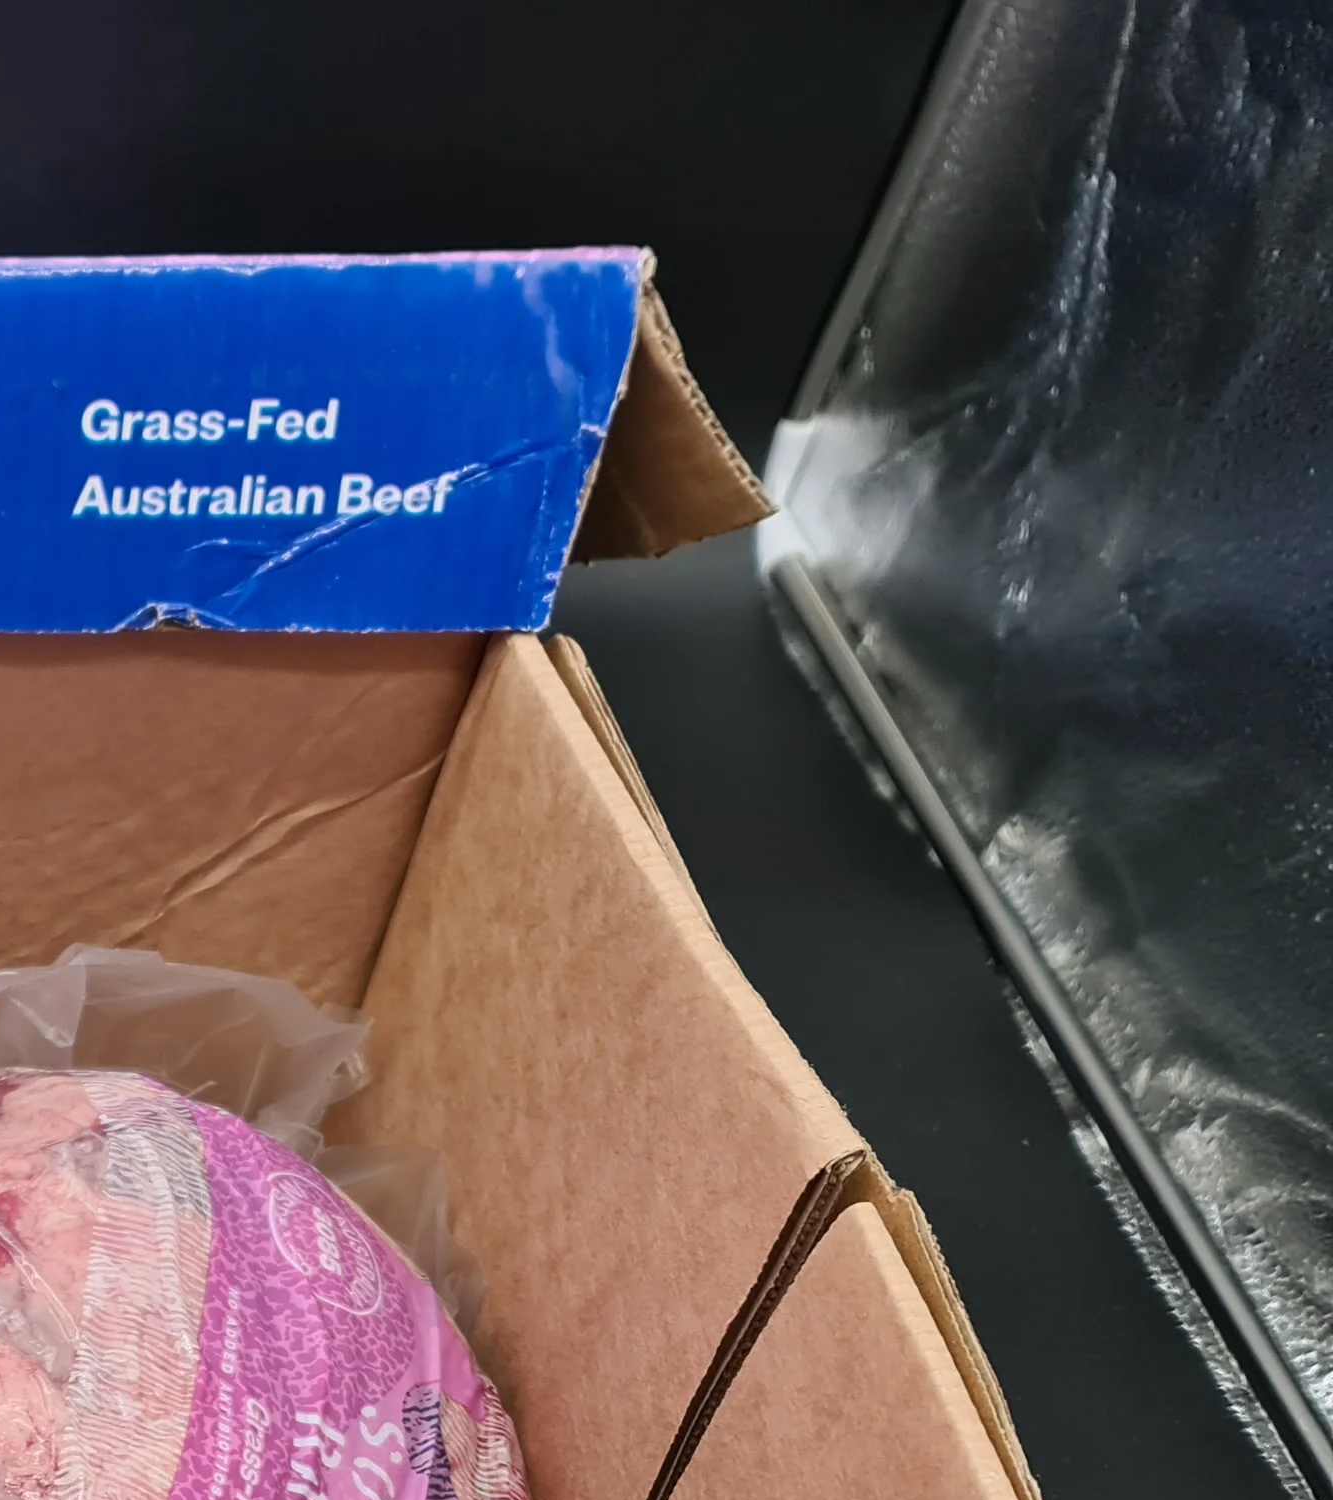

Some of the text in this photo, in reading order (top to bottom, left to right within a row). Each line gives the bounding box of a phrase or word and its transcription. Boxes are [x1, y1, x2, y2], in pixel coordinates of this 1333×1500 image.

[78, 396, 340, 446] Grass-Fed
[71, 470, 457, 519] Australian Beef
[227, 1286, 240, 1311] NO
[219, 1316, 240, 1375] ADDED
